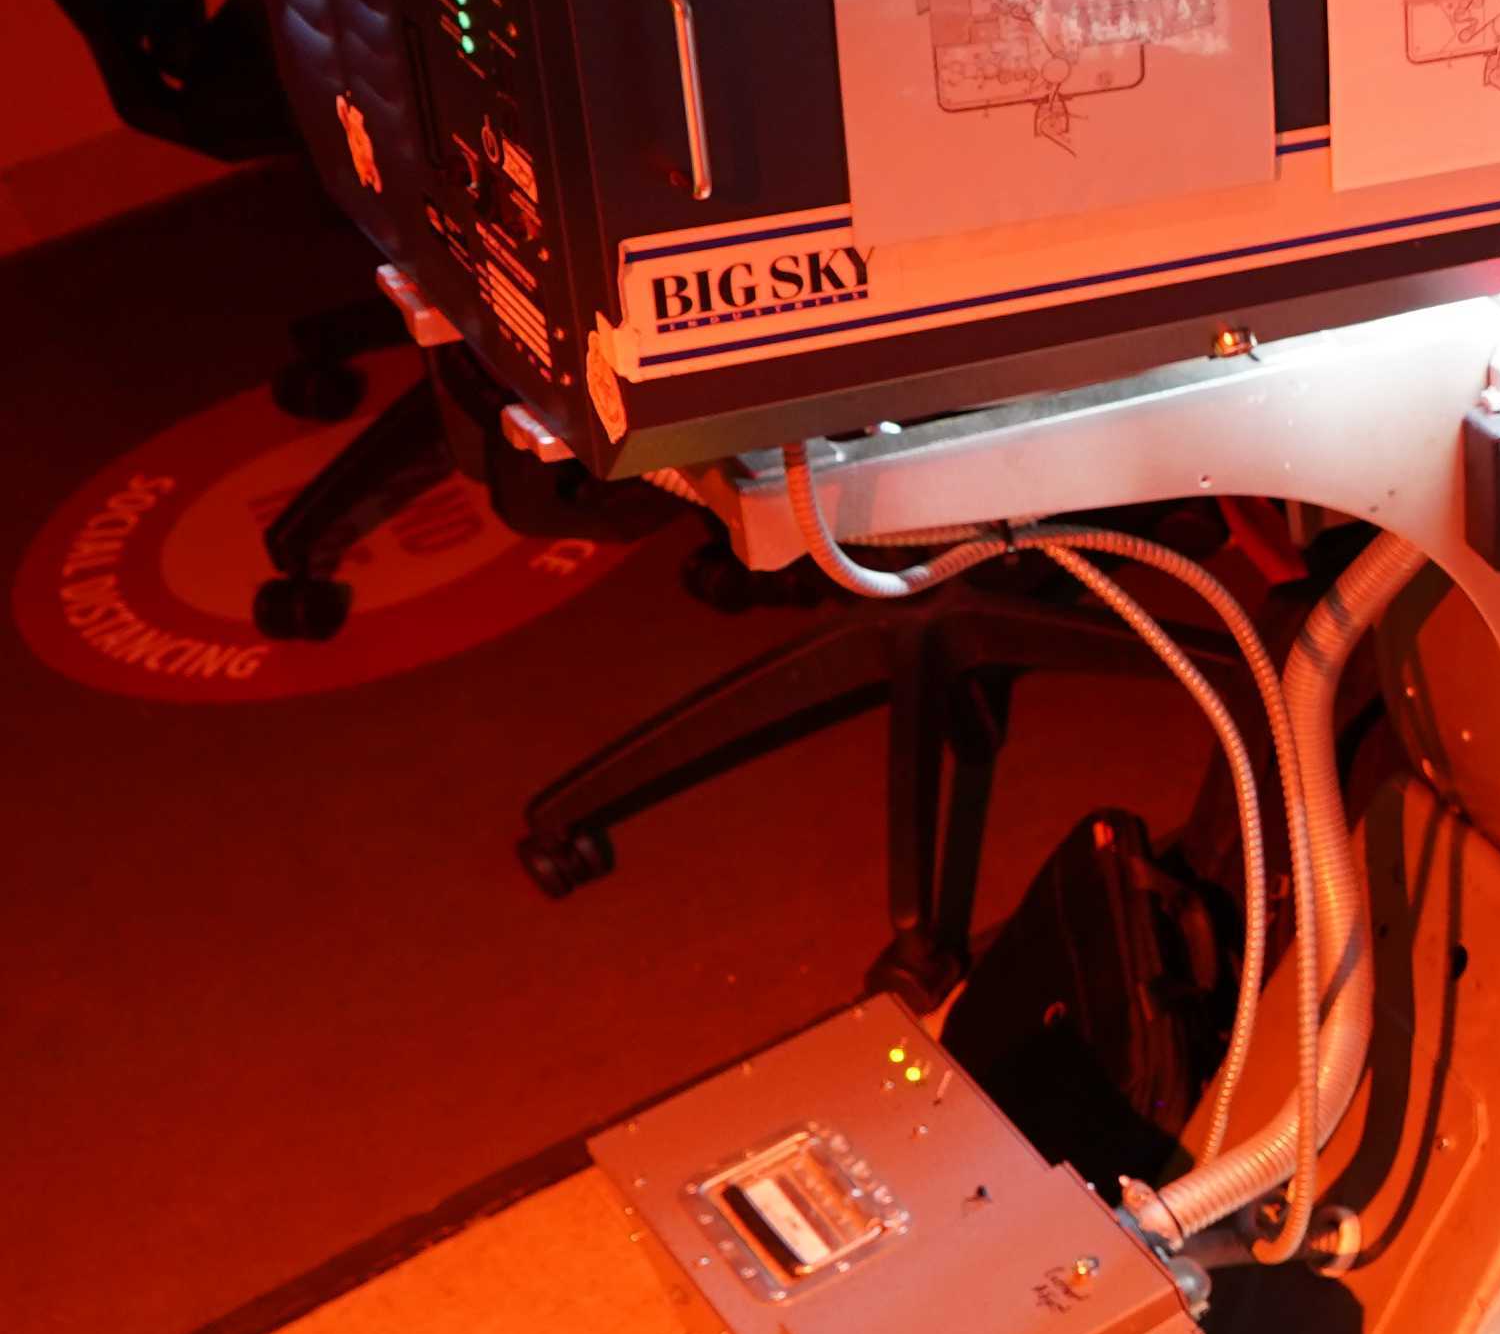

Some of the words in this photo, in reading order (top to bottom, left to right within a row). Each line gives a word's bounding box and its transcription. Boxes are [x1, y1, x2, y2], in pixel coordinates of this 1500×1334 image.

[652, 262, 760, 320] BIG
[769, 245, 877, 301] SKY
[62, 473, 176, 578] SOCIAL
[60, 575, 271, 679] DISTANCING
